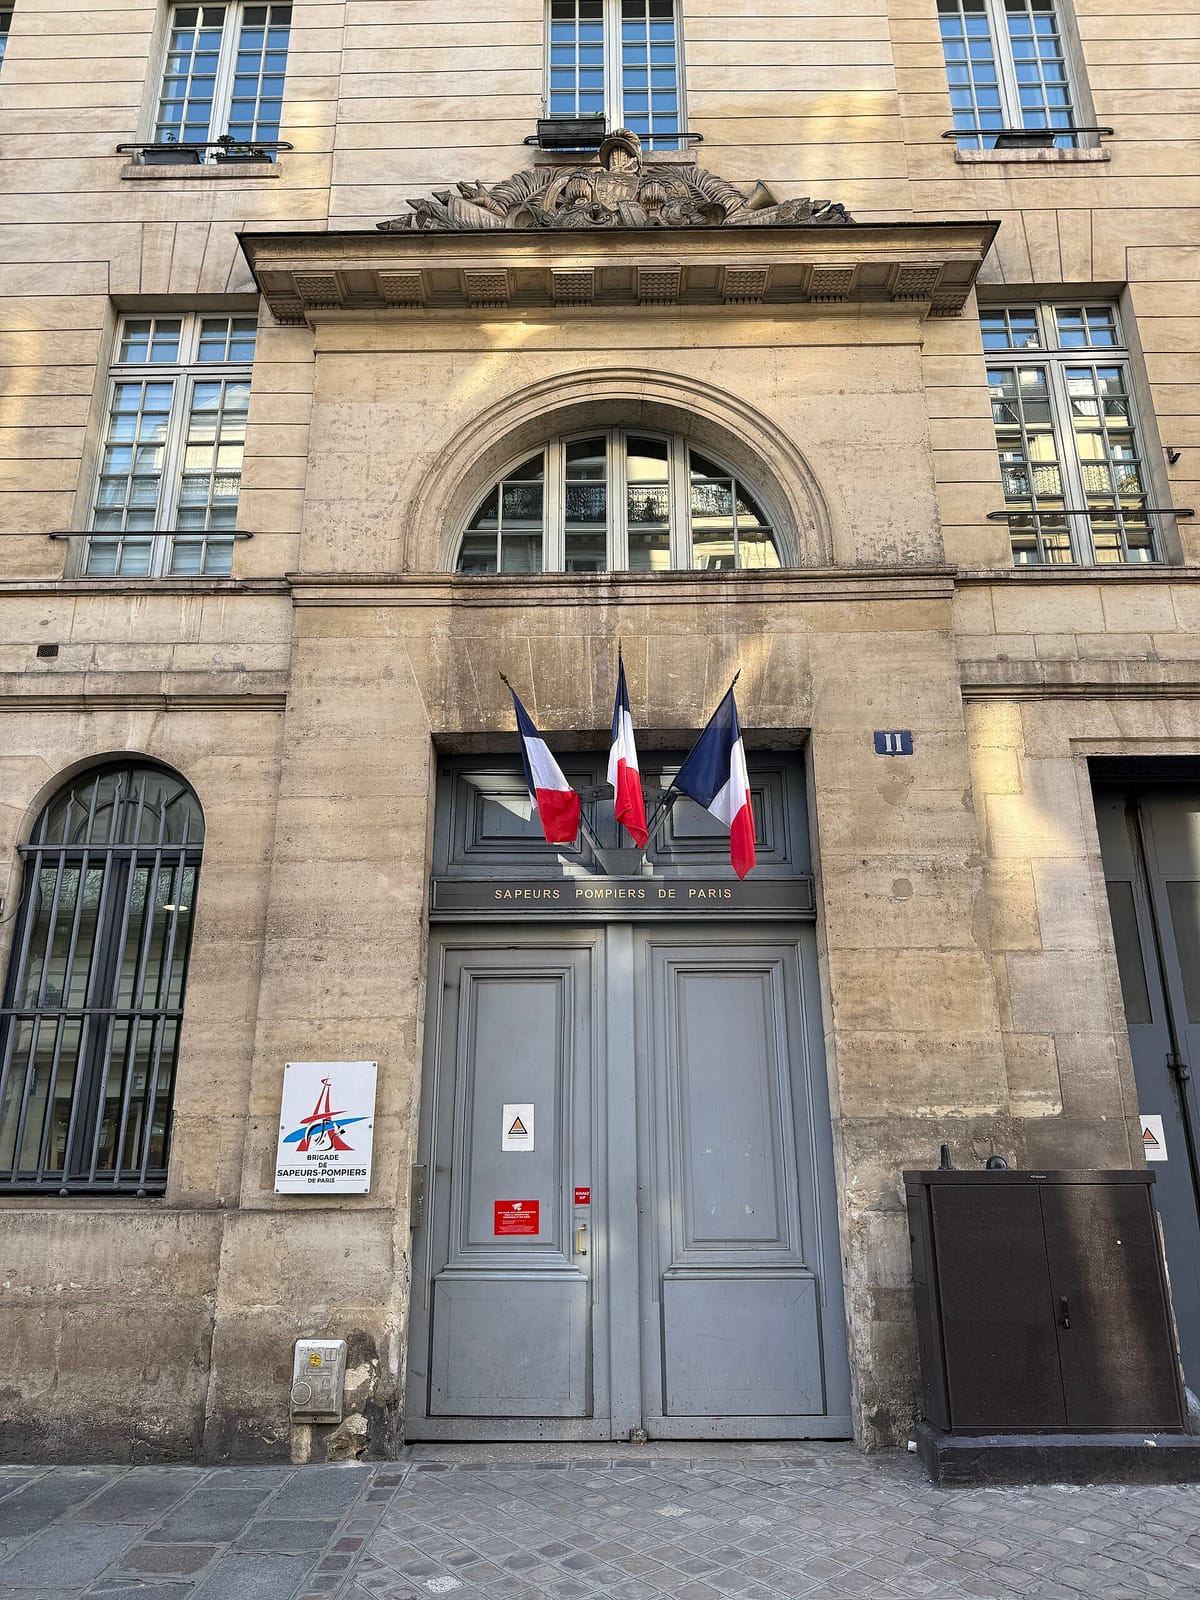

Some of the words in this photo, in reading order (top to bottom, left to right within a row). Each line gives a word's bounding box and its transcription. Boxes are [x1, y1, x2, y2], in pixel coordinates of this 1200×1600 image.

[494, 889, 561, 899] SAPEURS
[575, 889, 646, 899] POMPIERS
[658, 888, 676, 898] DE
[688, 888, 732, 898] PARIS
[277, 1169, 366, 1177] SAPEURS-POMPIERS
